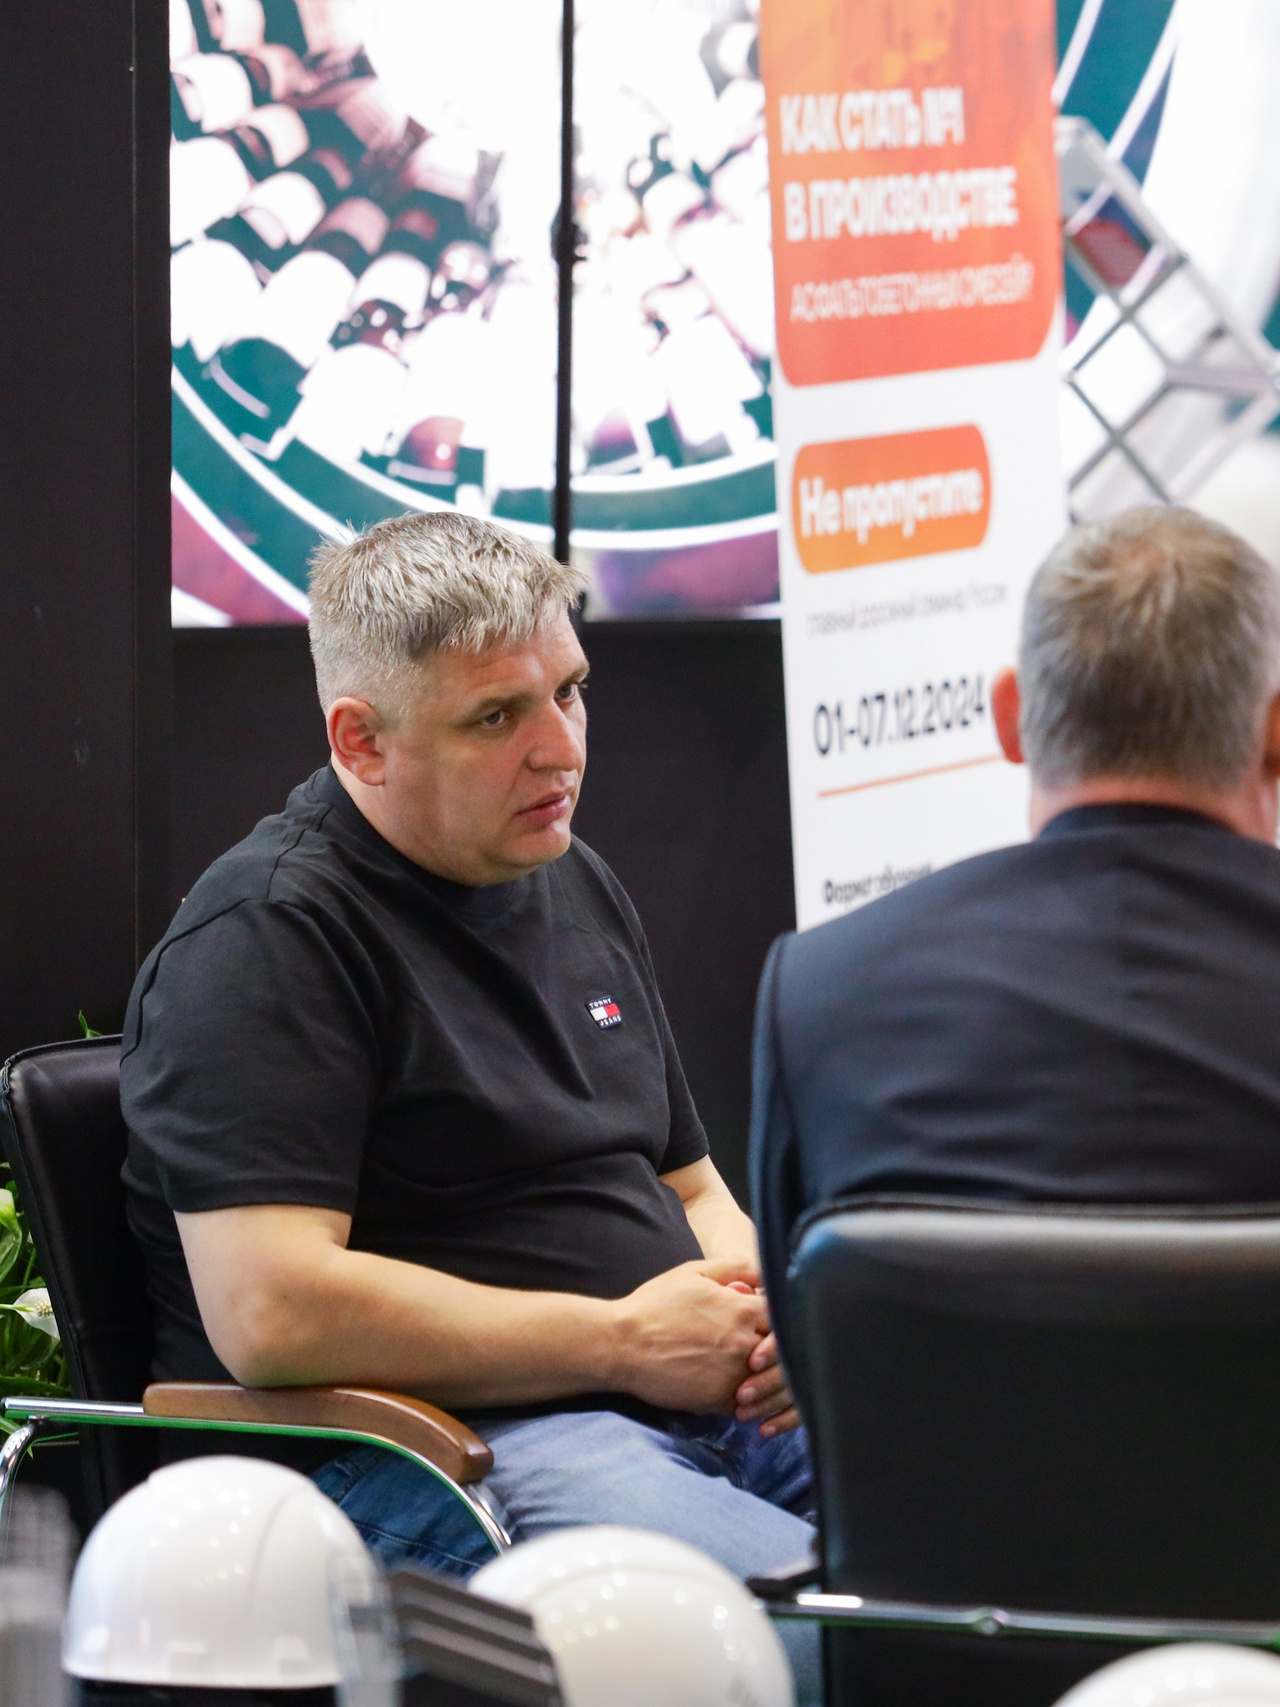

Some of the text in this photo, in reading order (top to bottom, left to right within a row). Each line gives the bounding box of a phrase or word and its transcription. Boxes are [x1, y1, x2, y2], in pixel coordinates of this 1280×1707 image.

[779, 92, 841, 155] КАК
[839, 88, 921, 150] СТАТЬ
[784, 165, 1019, 243] В ПРОИЗВОДСТВЕ
[799, 467, 984, 546] Не пропустите
[813, 672, 985, 756] 01-07.12.2024
[588, 997, 612, 1009] TOMMY
[600, 1014, 622, 1026] JEANS
